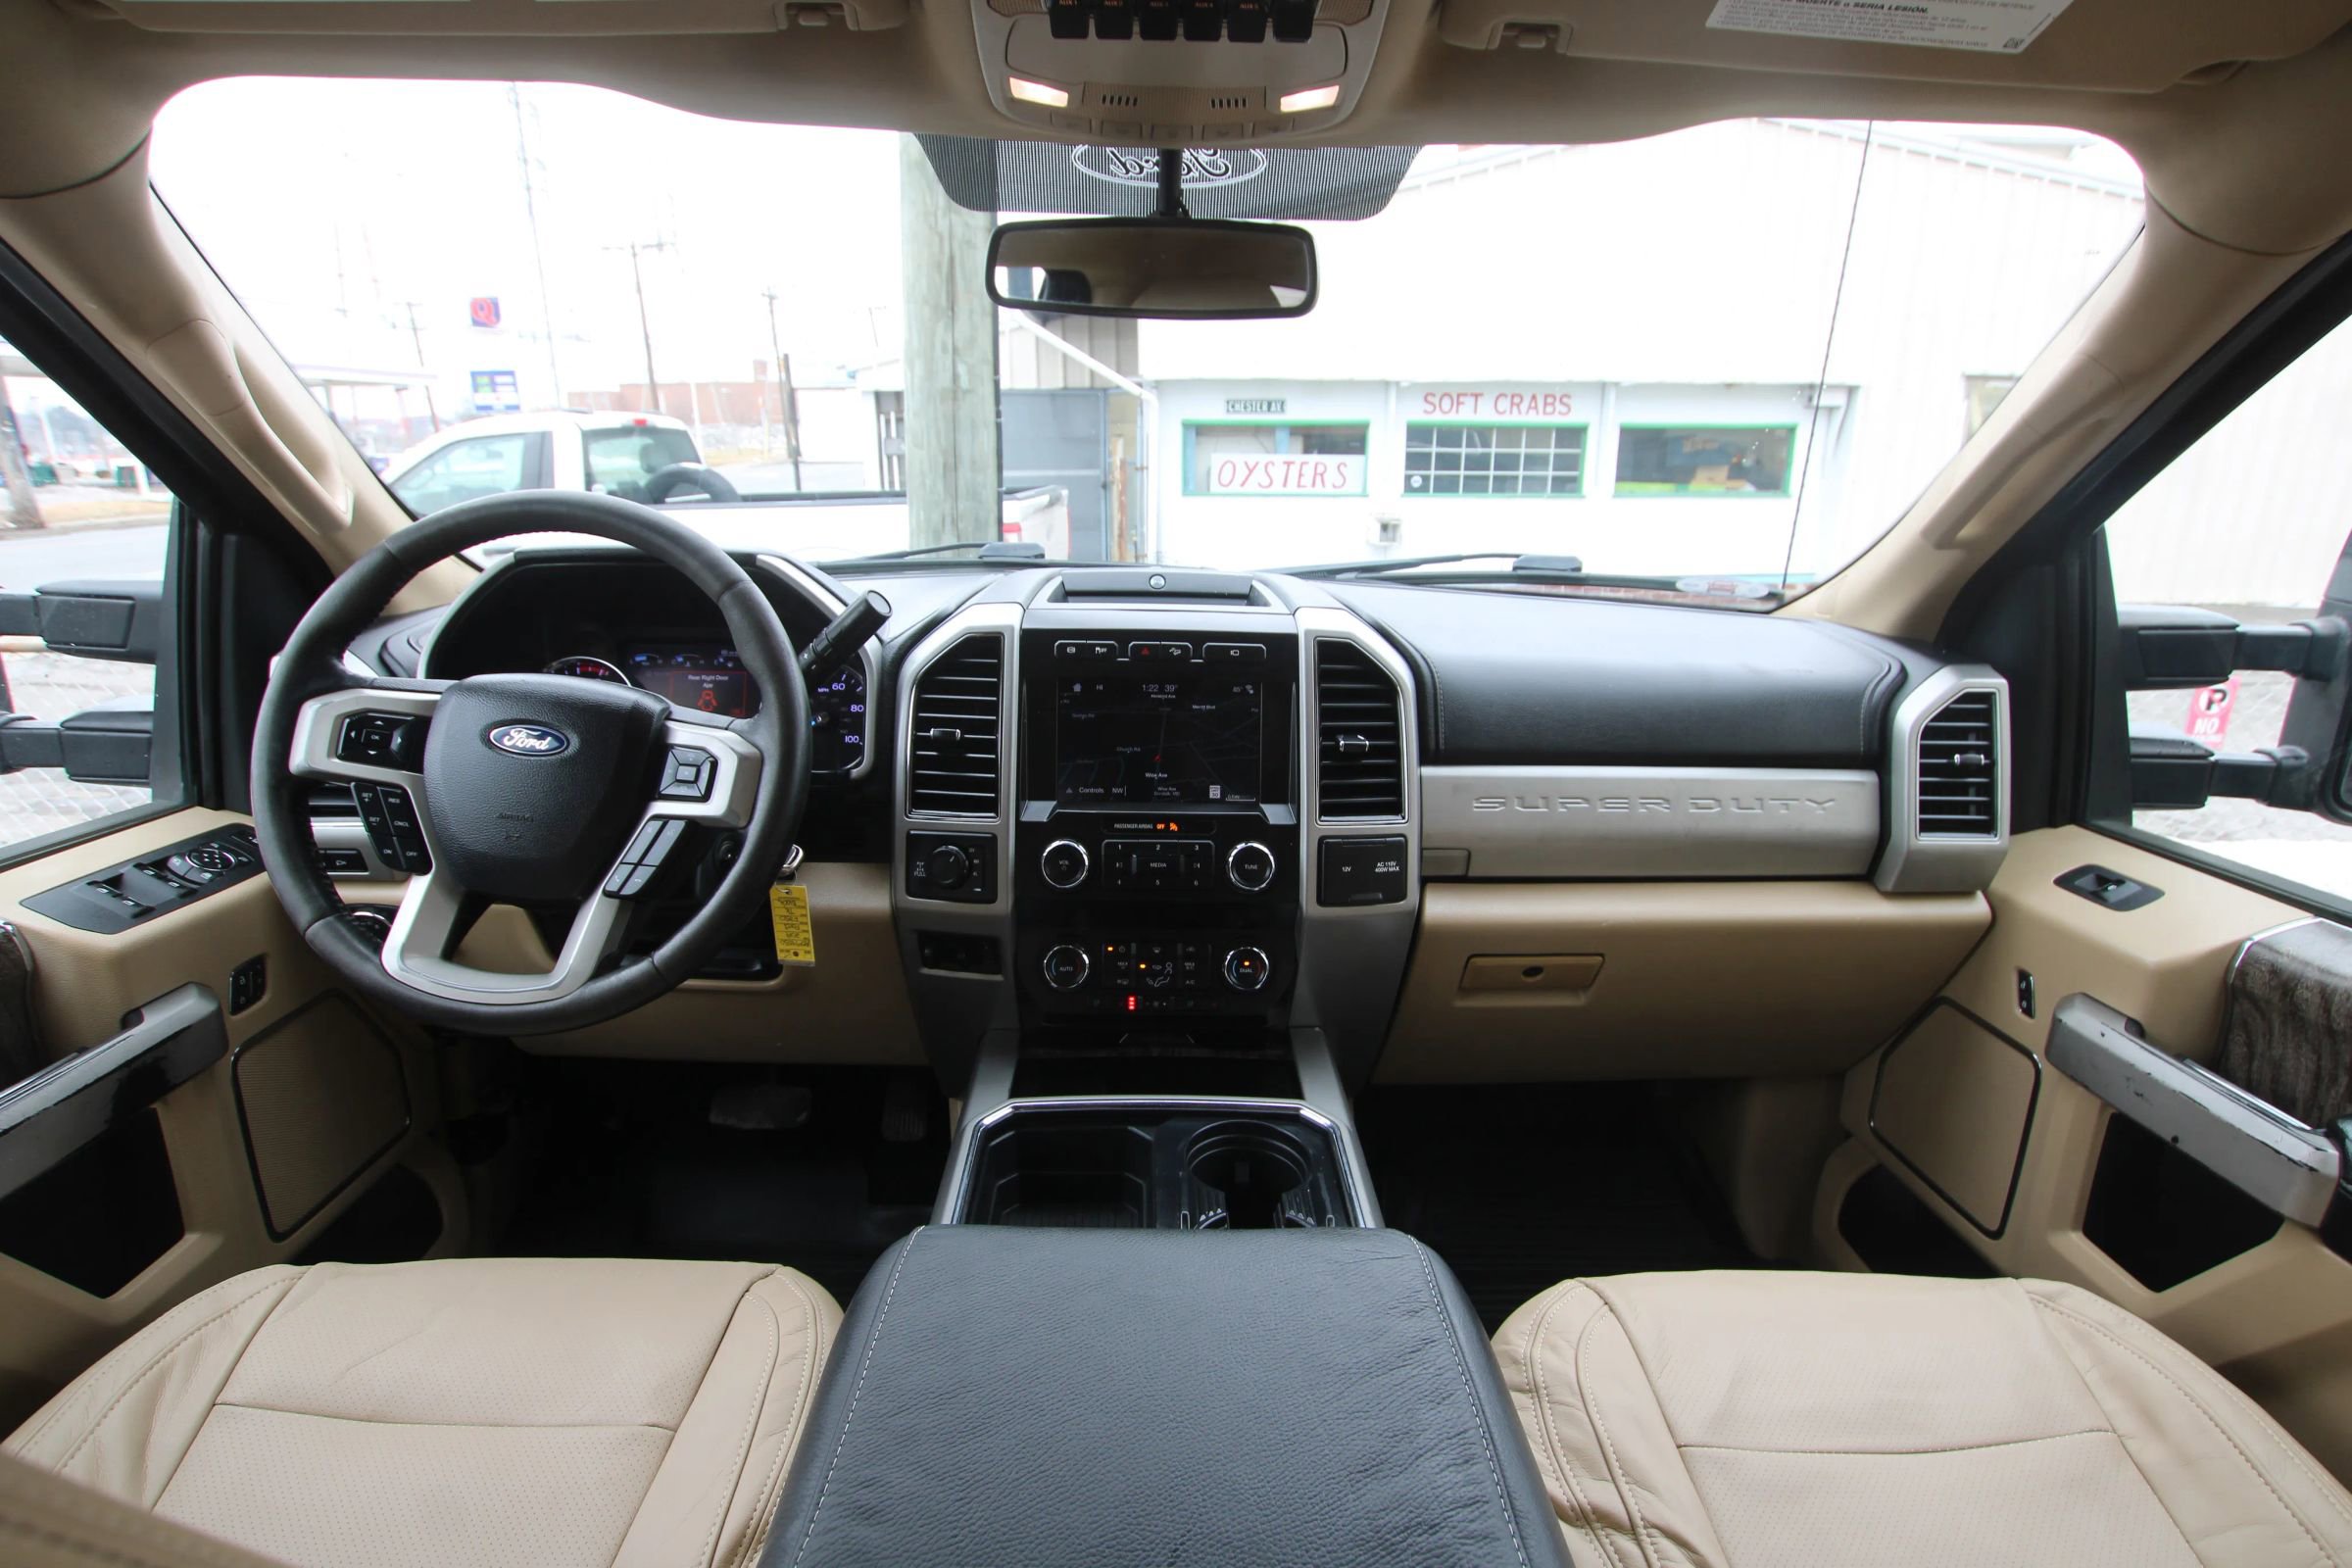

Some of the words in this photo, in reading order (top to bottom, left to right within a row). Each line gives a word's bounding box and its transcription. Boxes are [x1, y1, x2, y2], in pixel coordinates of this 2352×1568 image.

[1853, 2, 1885, 11] SERIA
[1228, 400, 1266, 412] CHESTER
[1423, 392, 1484, 415] SOFT
[1494, 392, 1573, 416] CRABS
[1217, 460, 1348, 489] OYSTERS
[2194, 717, 2220, 735] NO
[503, 728, 551, 751] Ford
[1473, 796, 1671, 813] SUPER
[1689, 797, 1836, 814] DUTY
